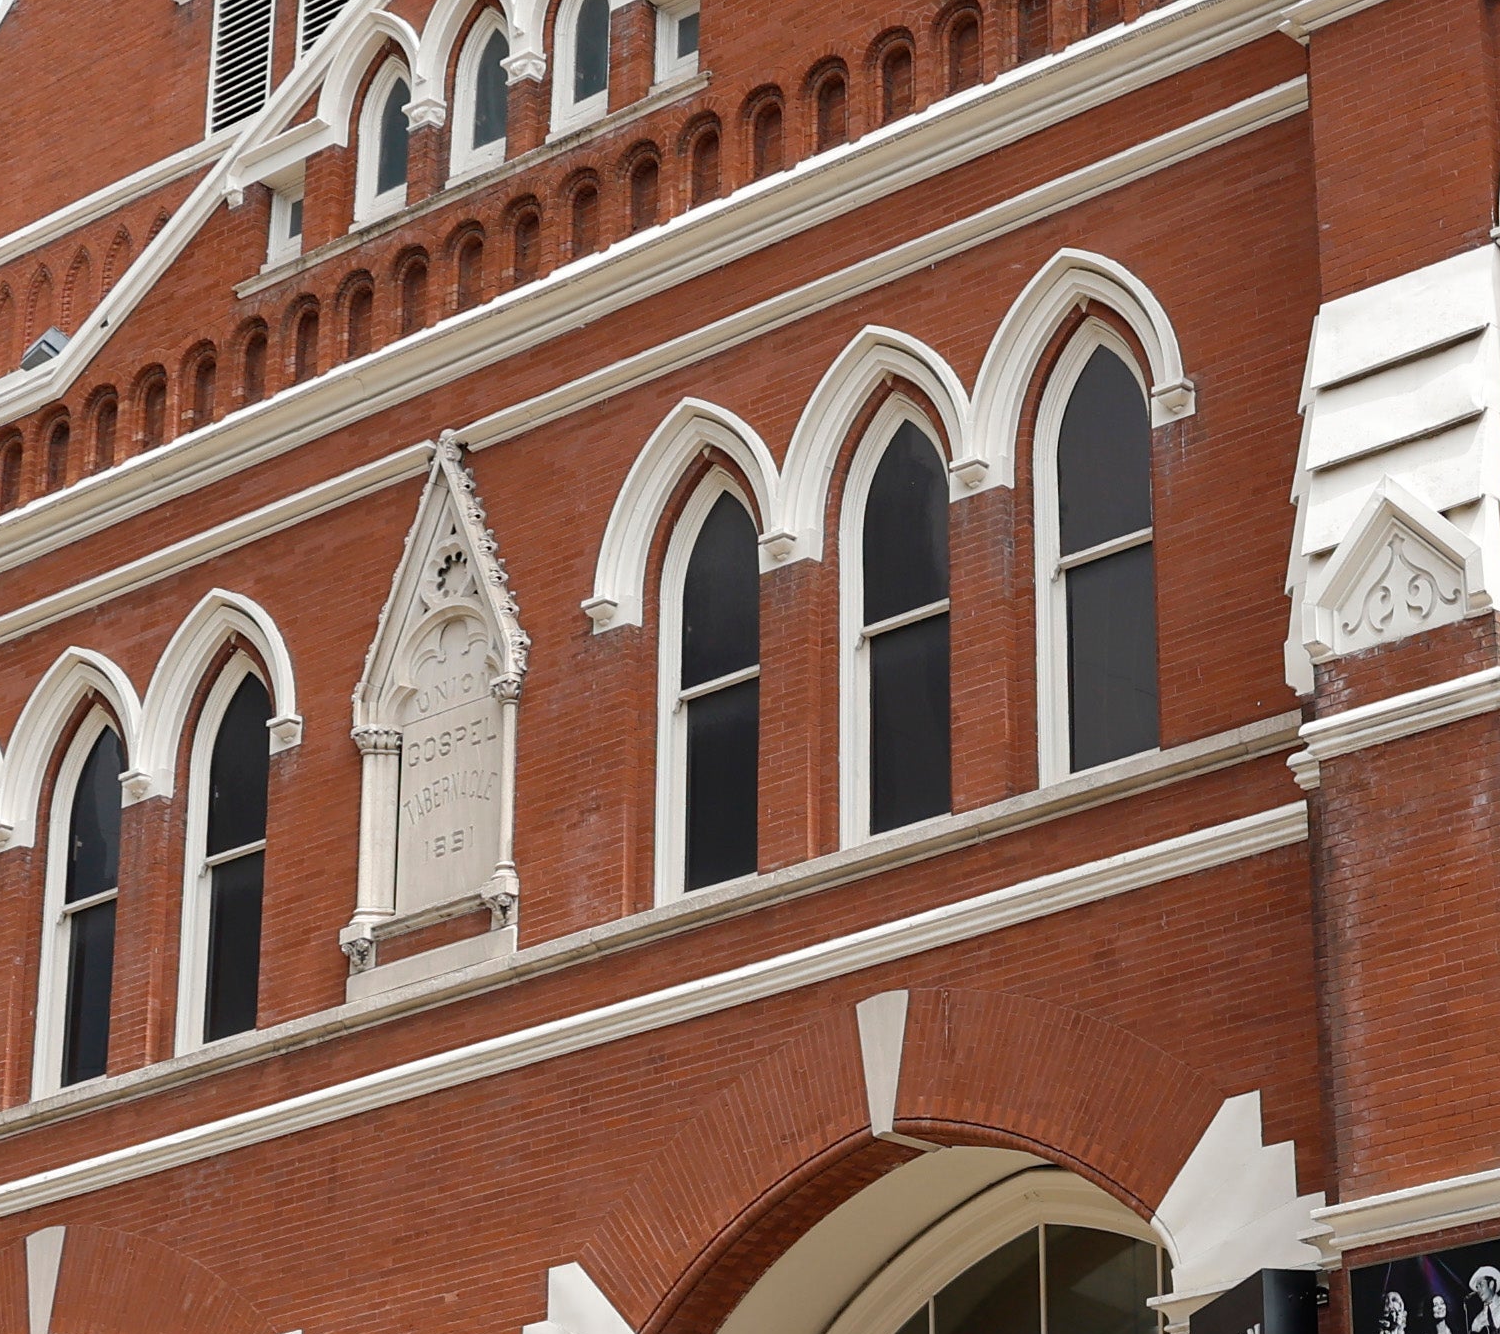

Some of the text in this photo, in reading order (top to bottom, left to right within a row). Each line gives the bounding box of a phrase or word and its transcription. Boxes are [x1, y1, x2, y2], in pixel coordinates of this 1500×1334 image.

[415, 671, 492, 713] UNION
[408, 717, 497, 767] GOSPEL
[403, 769, 498, 825] TABERNACLE
